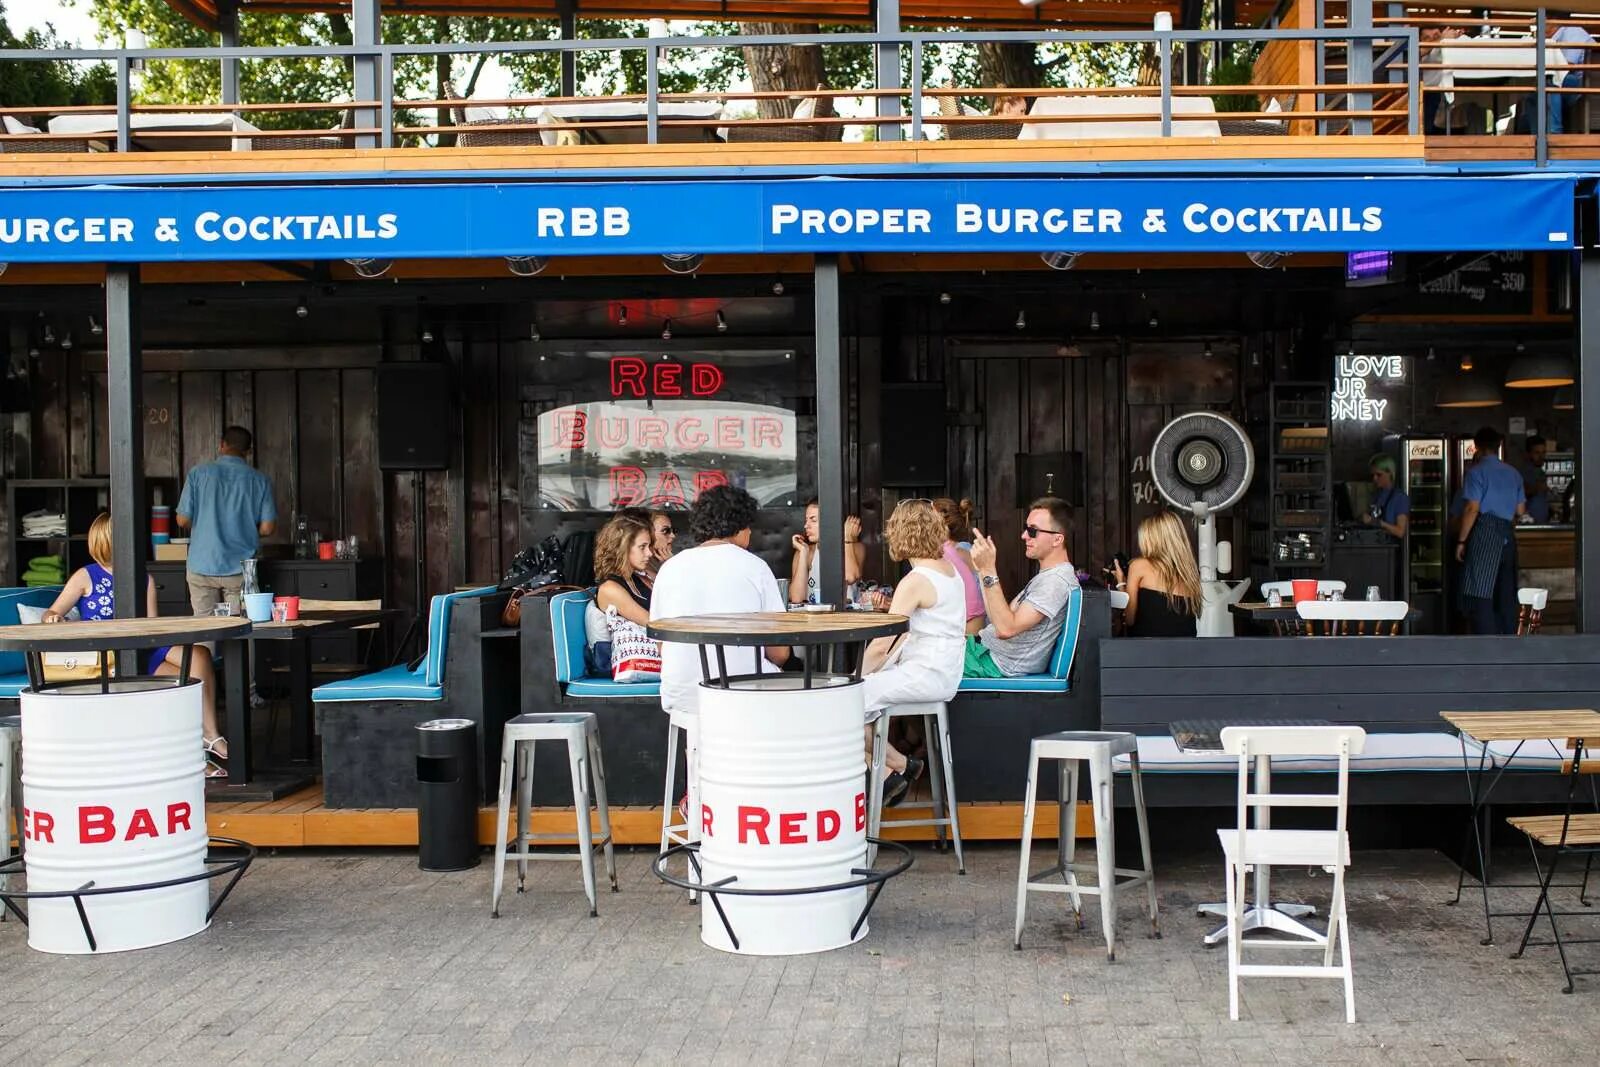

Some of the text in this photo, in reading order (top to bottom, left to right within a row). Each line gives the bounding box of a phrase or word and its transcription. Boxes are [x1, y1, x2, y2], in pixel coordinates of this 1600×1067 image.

[154, 217, 179, 242] &
[194, 211, 398, 241] COCKTAILS
[537, 206, 630, 237] RBB
[772, 203, 1383, 234] PROPER BURGER & COCKTAILS
[609, 356, 724, 397] RED
[1340, 355, 1403, 378] LOVE
[551, 409, 784, 450] BURGER
[79, 801, 191, 844] BAR
[738, 805, 841, 845] RED
